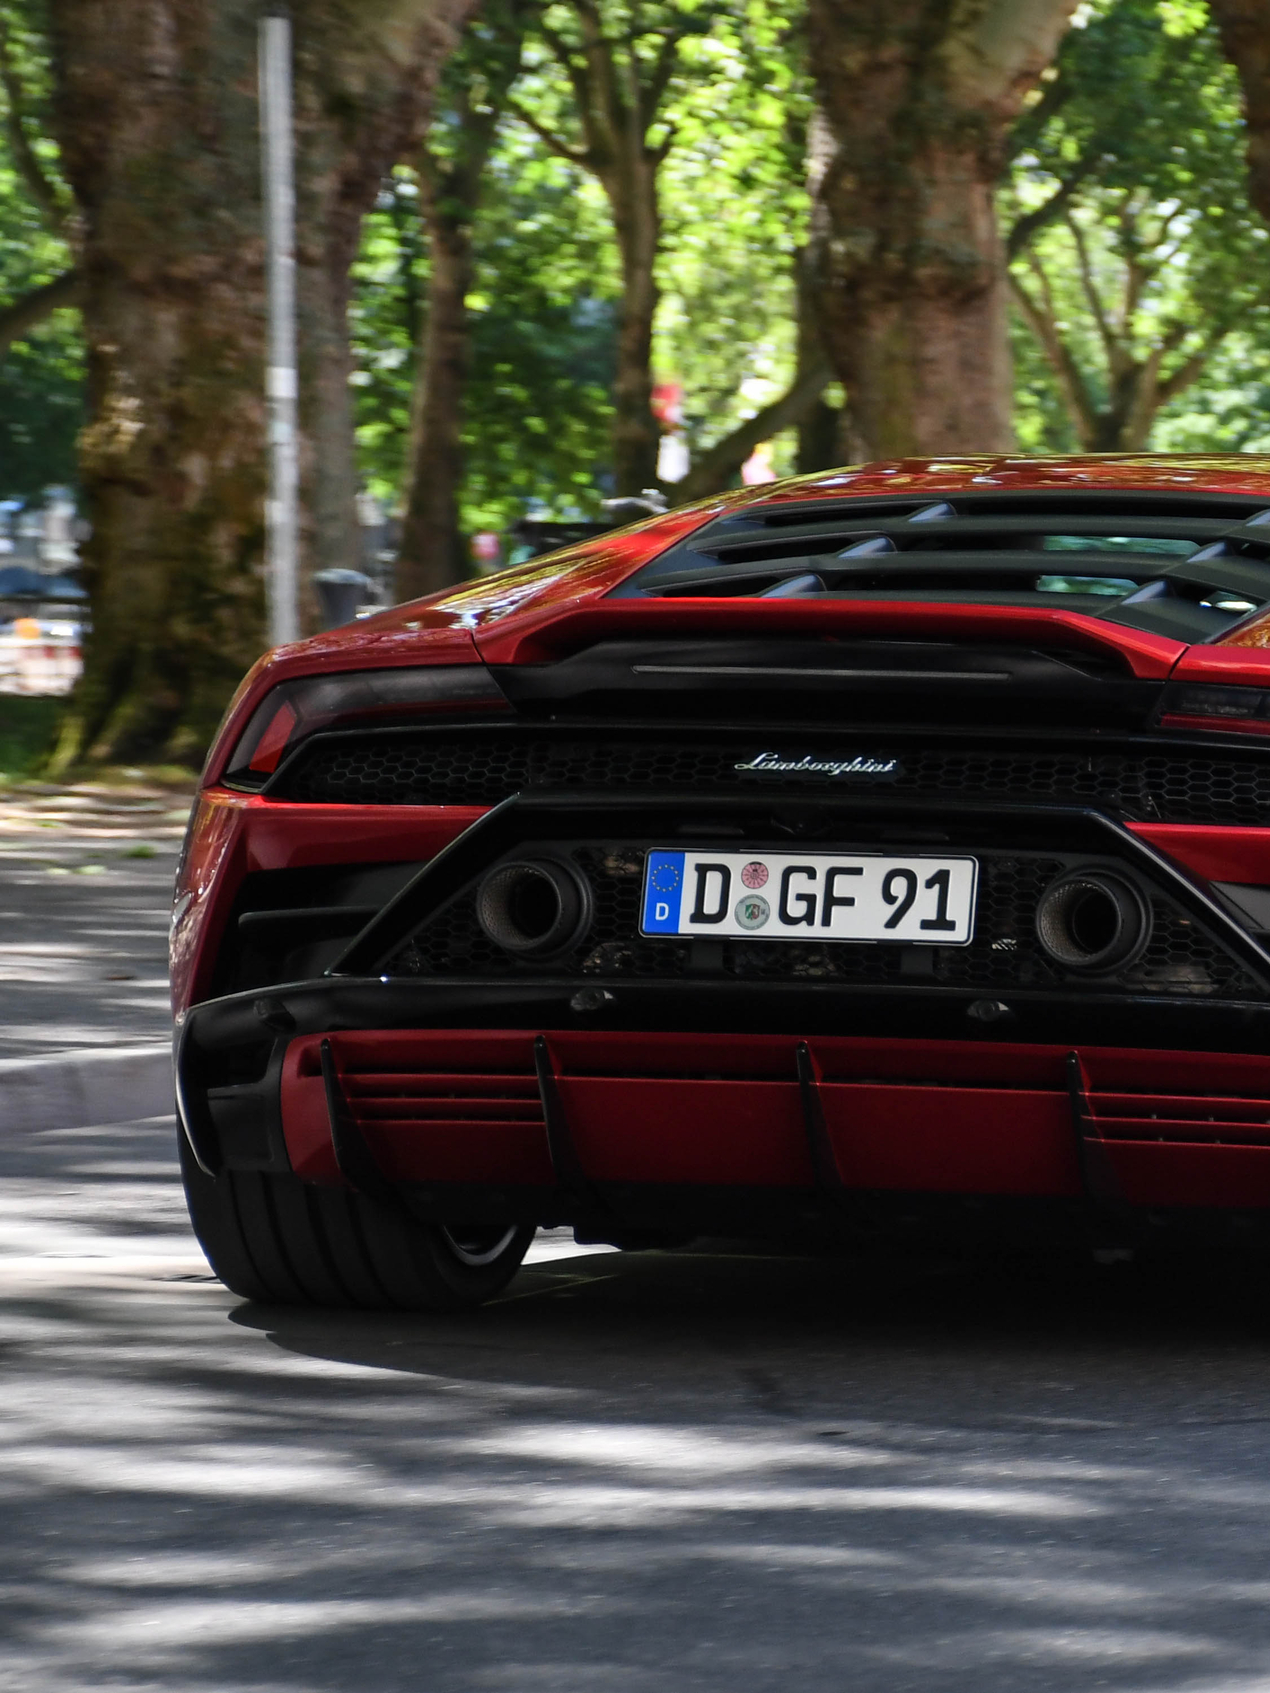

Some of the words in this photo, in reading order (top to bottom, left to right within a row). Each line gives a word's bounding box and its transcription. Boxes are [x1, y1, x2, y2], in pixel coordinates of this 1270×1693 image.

[734, 751, 897, 776] Lamborghini
[689, 863, 732, 924] D
[778, 865, 864, 927] GF
[881, 868, 957, 932] 91
[655, 902, 670, 921] D
